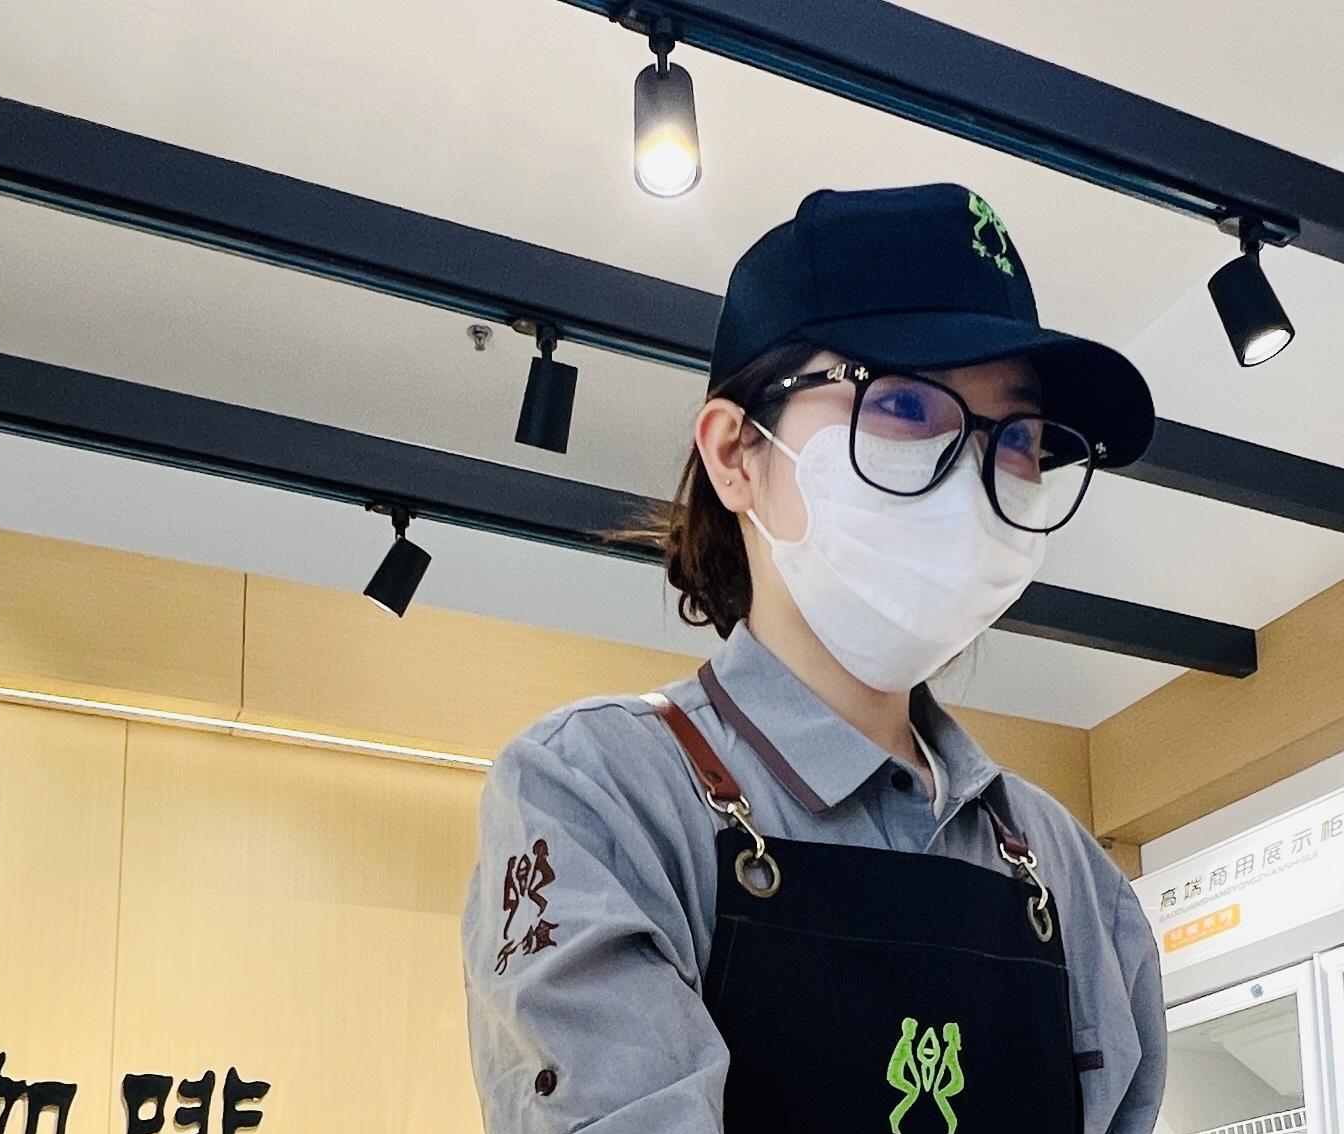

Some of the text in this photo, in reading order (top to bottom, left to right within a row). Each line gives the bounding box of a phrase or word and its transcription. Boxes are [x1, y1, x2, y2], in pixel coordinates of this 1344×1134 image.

[1160, 813, 1344, 910] 高端商用展示柜
